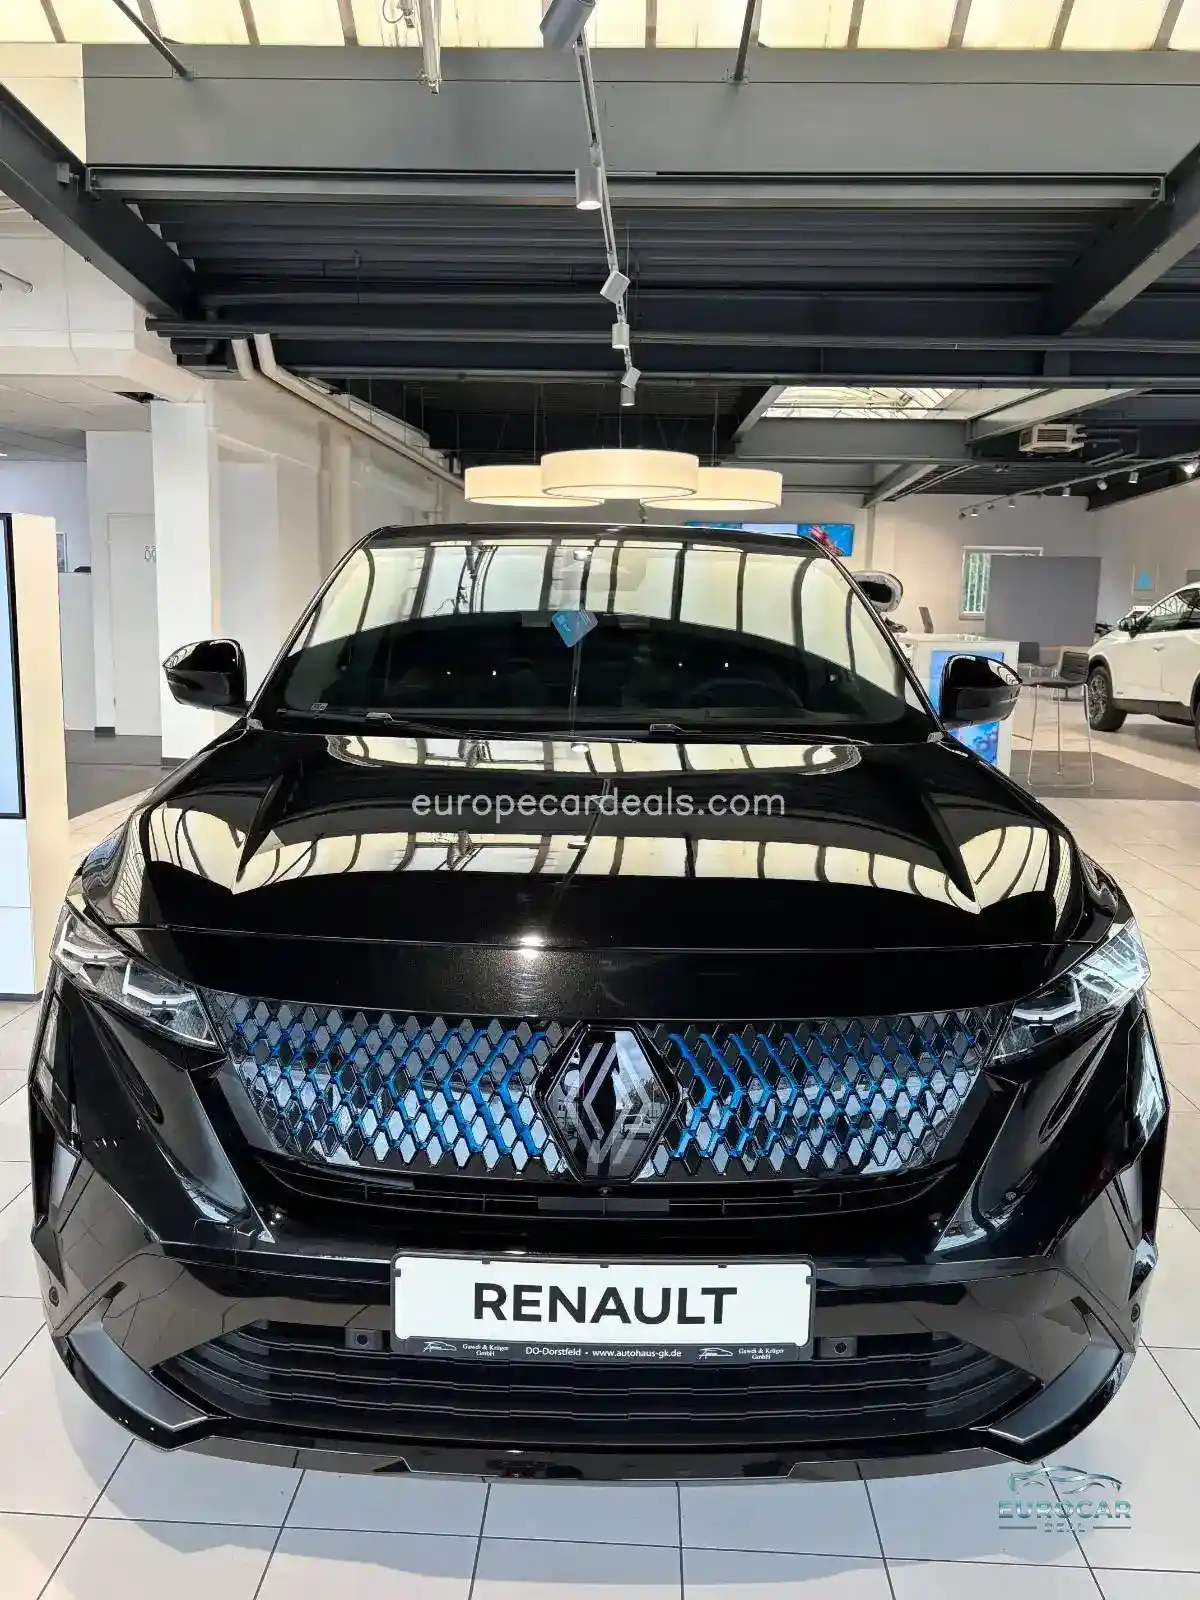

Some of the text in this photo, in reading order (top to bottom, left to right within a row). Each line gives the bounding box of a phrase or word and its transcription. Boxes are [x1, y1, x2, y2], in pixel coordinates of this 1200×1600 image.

[474, 1282, 738, 1325] RENAULT
[525, 1346, 682, 1359] DO-Dorstfeld www.autohaus-gk.de
